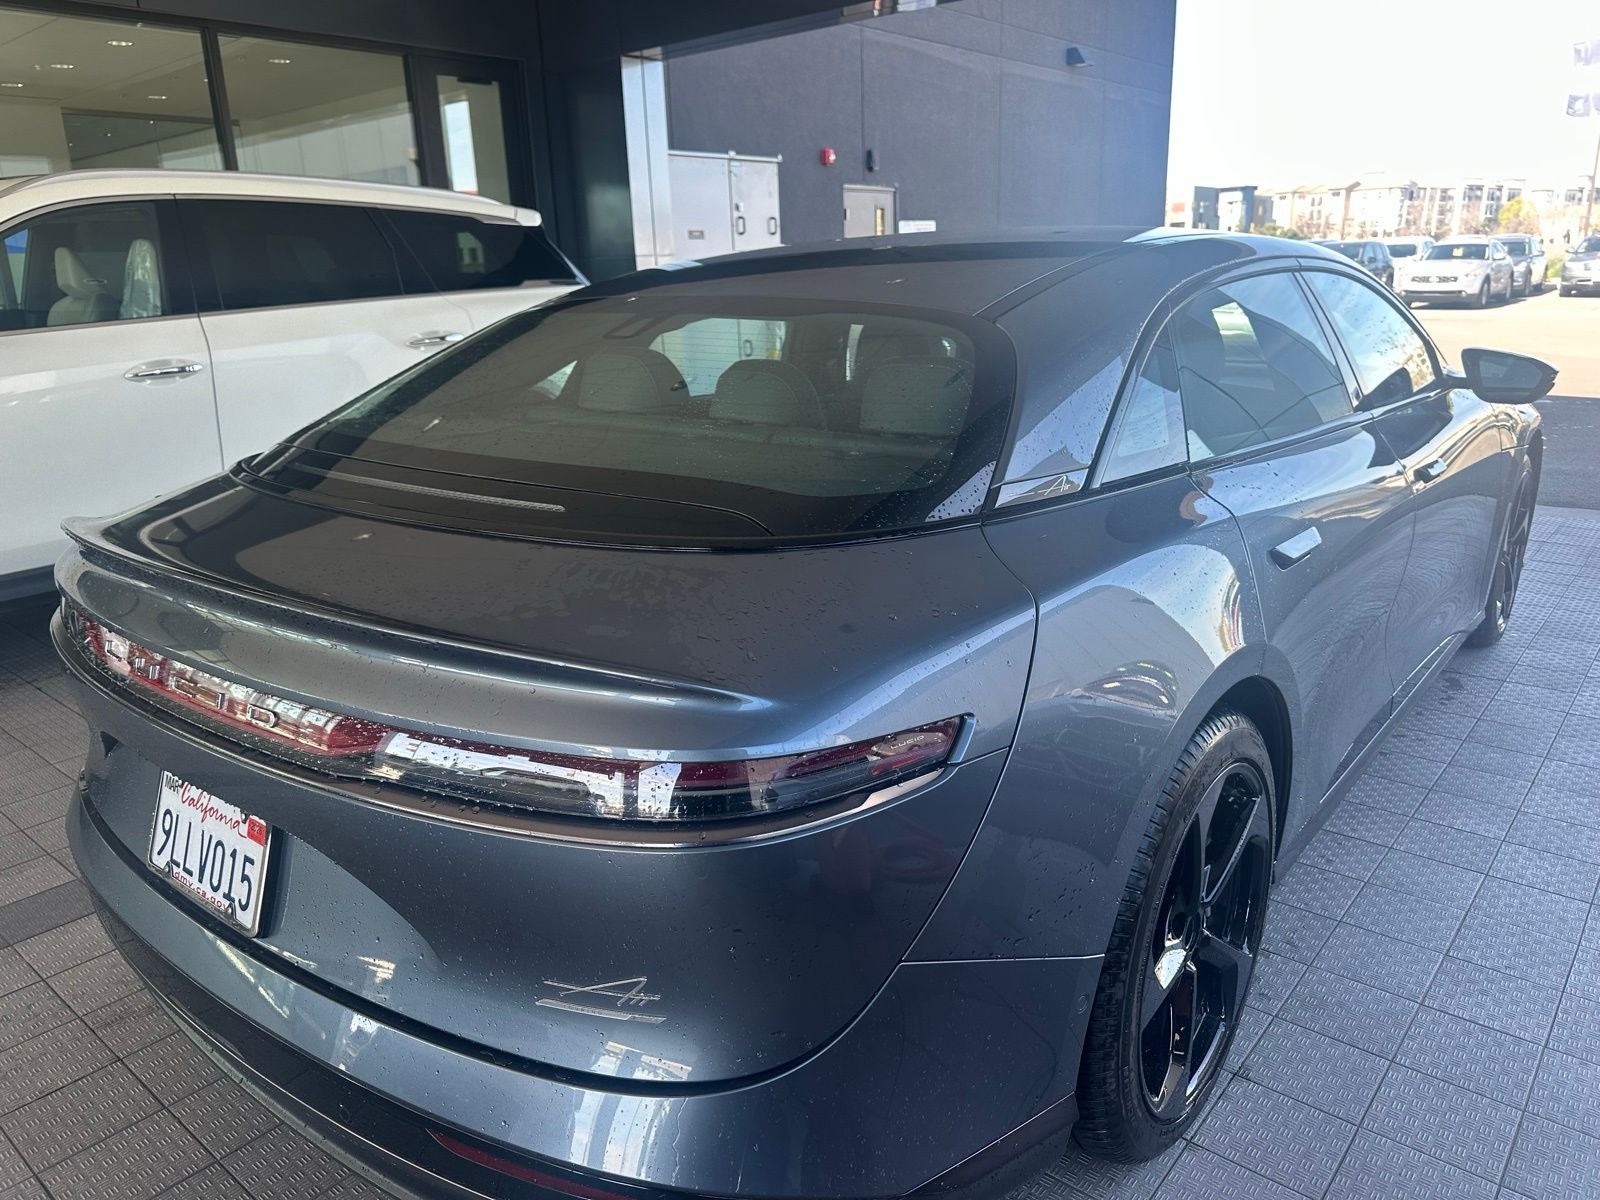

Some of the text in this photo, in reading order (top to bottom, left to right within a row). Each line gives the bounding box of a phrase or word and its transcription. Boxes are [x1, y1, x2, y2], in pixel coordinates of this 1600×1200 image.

[890, 735, 925, 750] LUCID
[181, 781, 248, 839] California
[157, 808, 255, 912] 9LLV015
